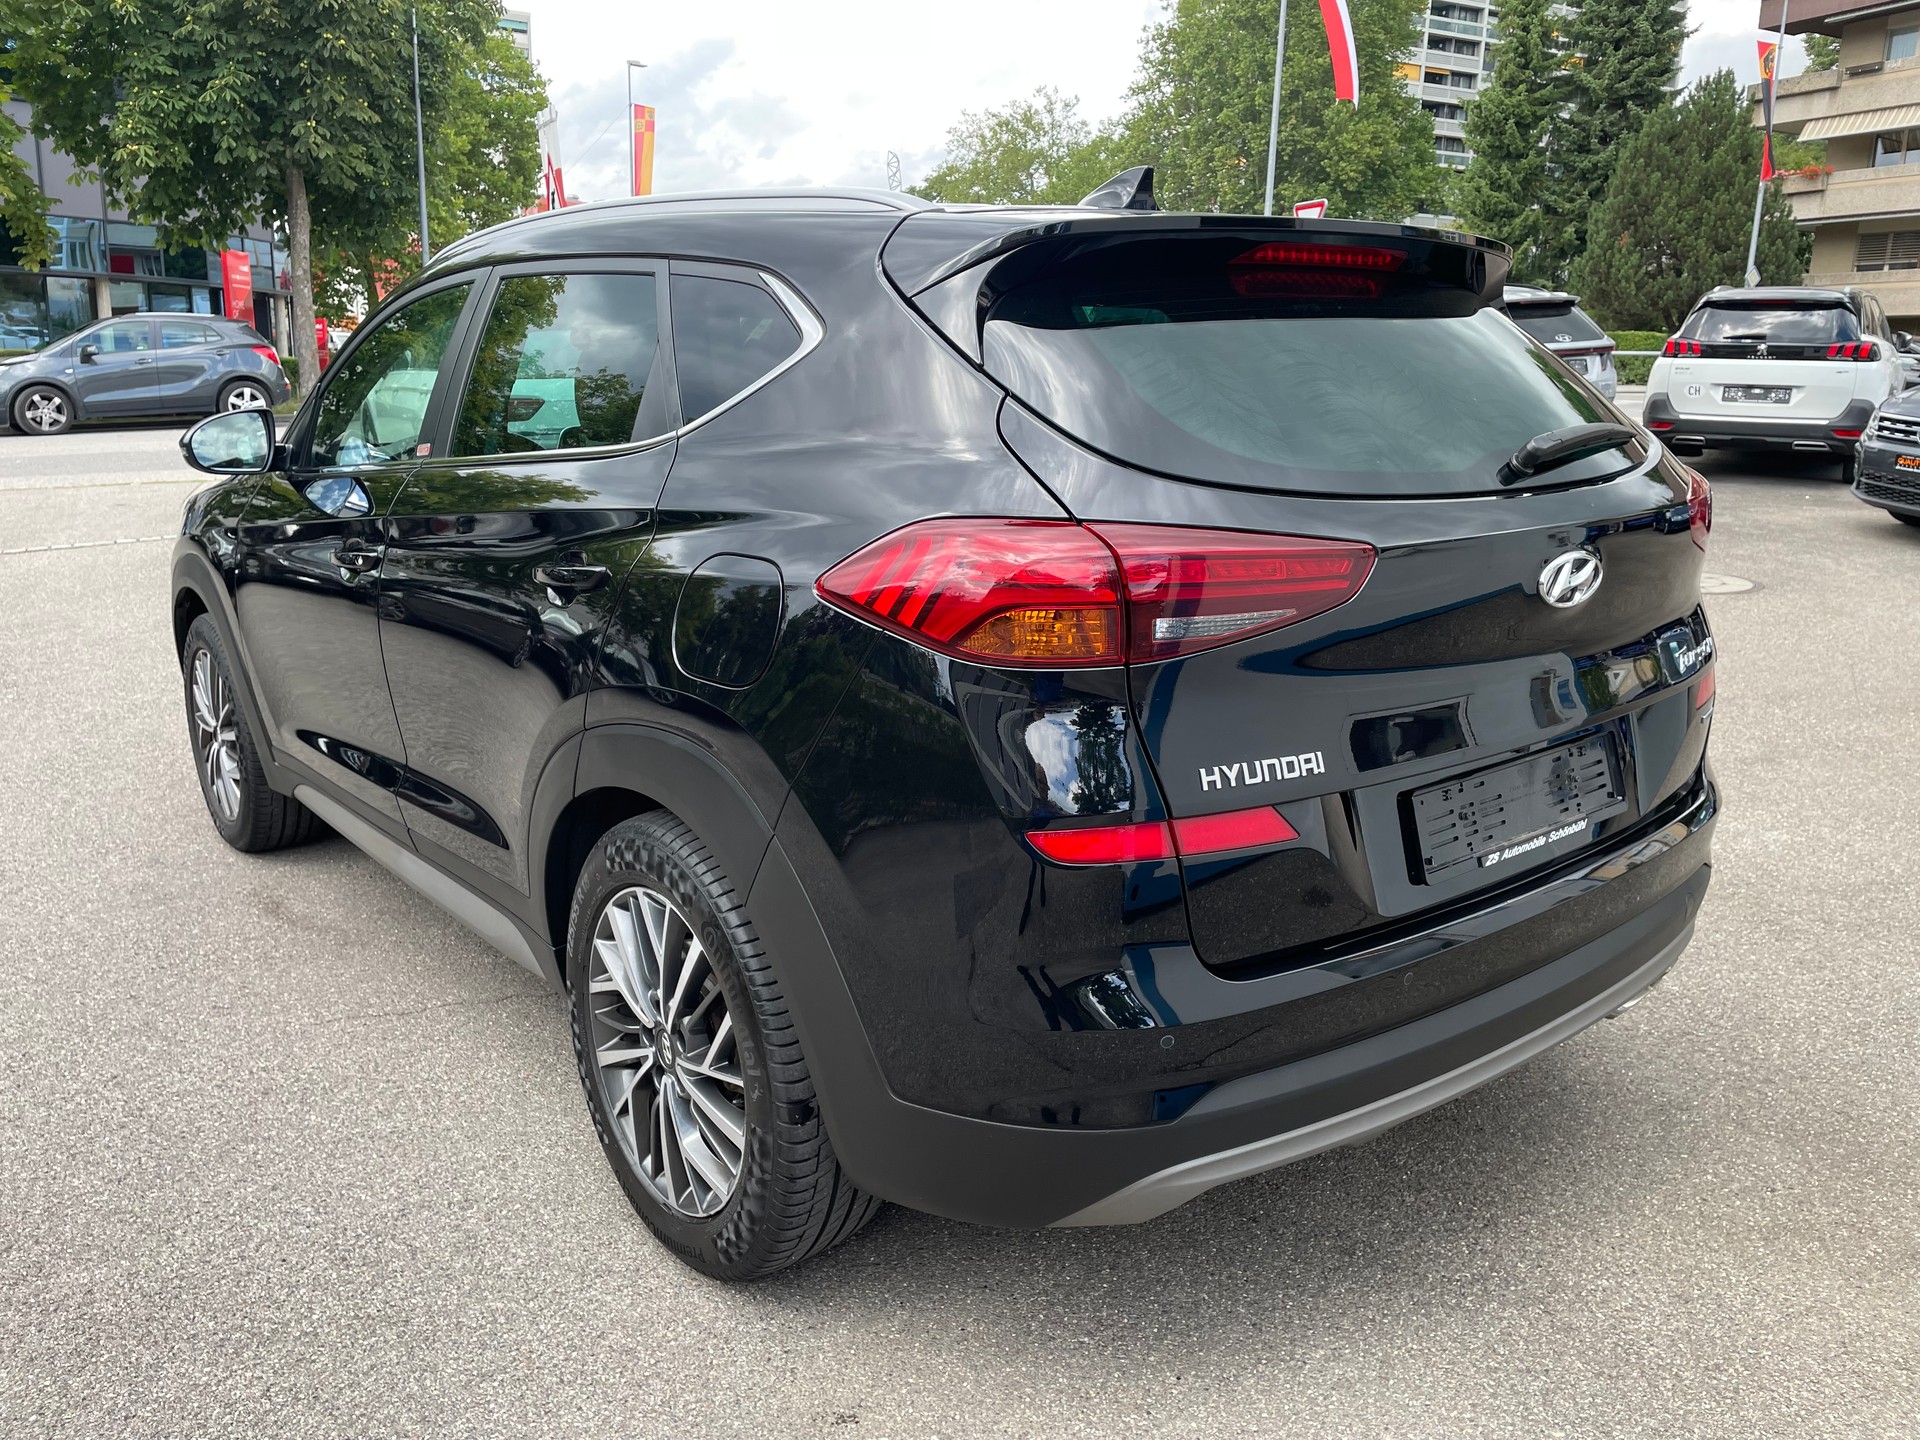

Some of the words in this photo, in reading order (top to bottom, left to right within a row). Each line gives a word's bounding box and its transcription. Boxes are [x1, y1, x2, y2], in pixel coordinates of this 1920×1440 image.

[1688, 386, 1701, 396] CH
[1198, 751, 1326, 792] HYUNDAI
[1484, 852, 1501, 867] ZS
[1501, 835, 1547, 861] Automobile
[1548, 818, 1588, 843] Schönbühl
